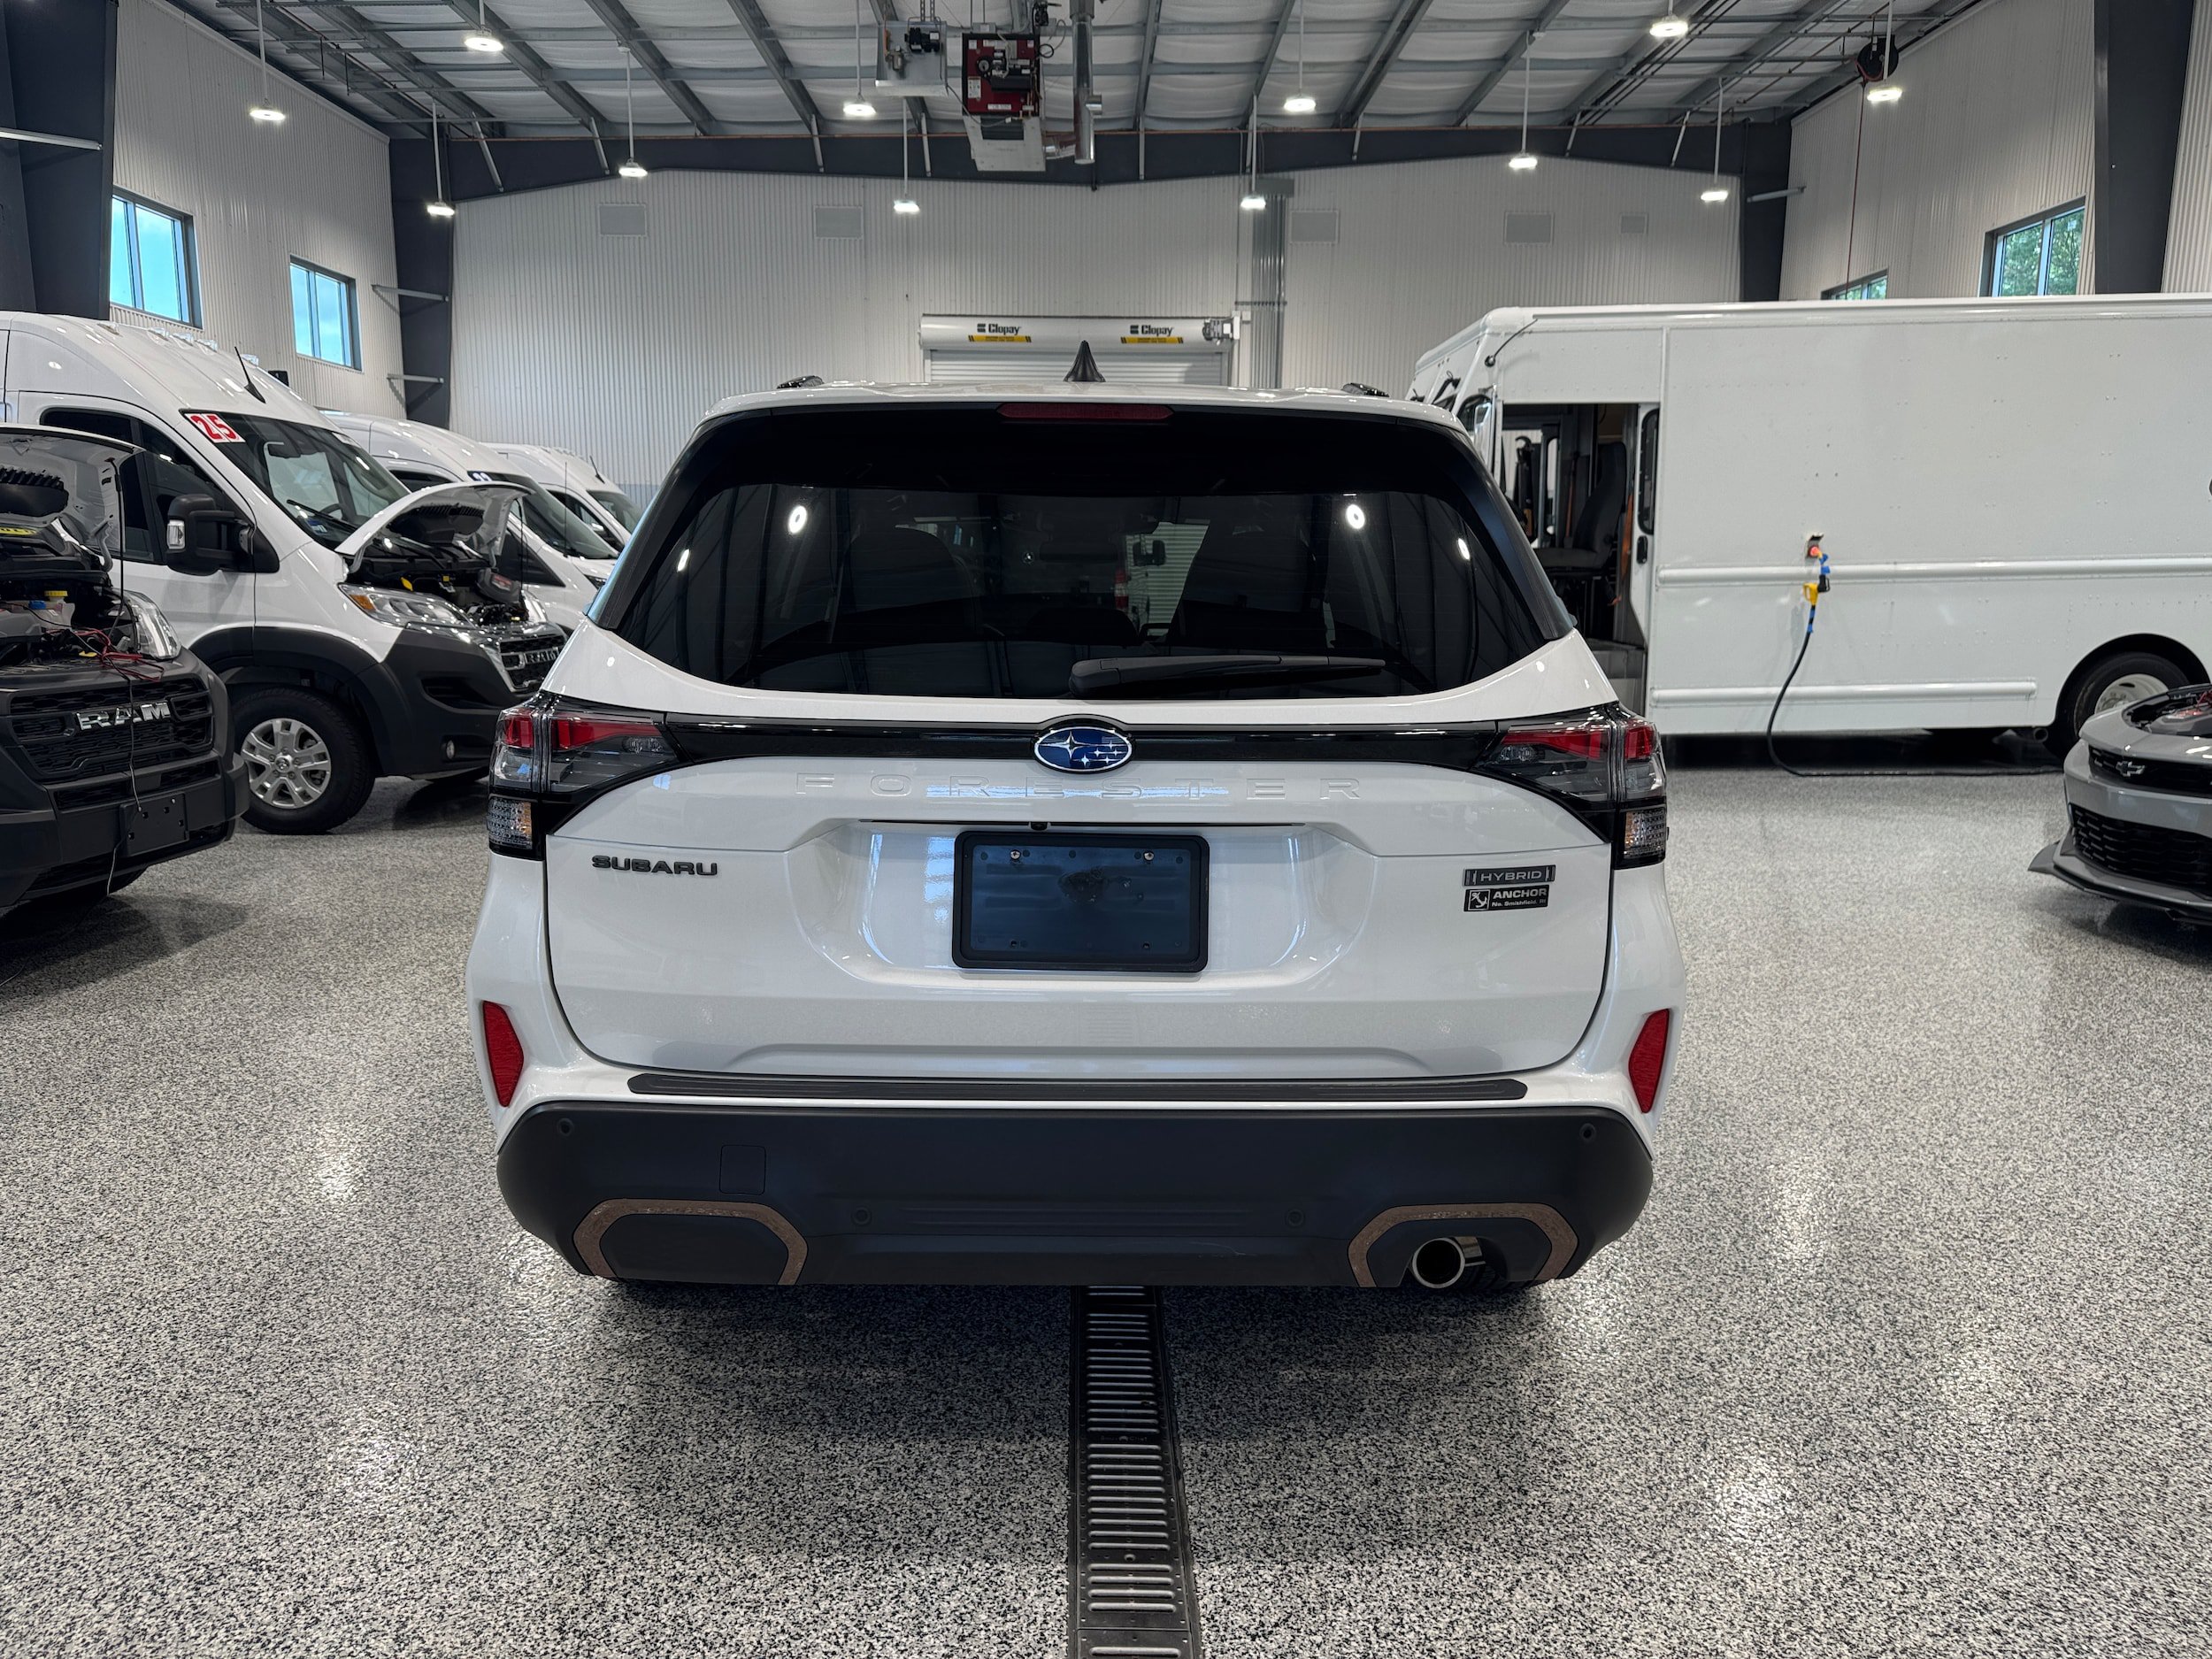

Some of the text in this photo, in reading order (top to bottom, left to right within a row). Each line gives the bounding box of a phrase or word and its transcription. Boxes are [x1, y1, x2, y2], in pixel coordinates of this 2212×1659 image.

[988, 323, 1021, 335] Clopay
[1141, 325, 1174, 337] Clopay
[190, 415, 236, 440] 25
[76, 703, 171, 731] RAM
[796, 772, 1360, 800] FORESTER
[592, 855, 718, 875] SUBARU
[1480, 871, 1542, 882] HYBRID
[1493, 887, 1547, 899] ANCHOR
